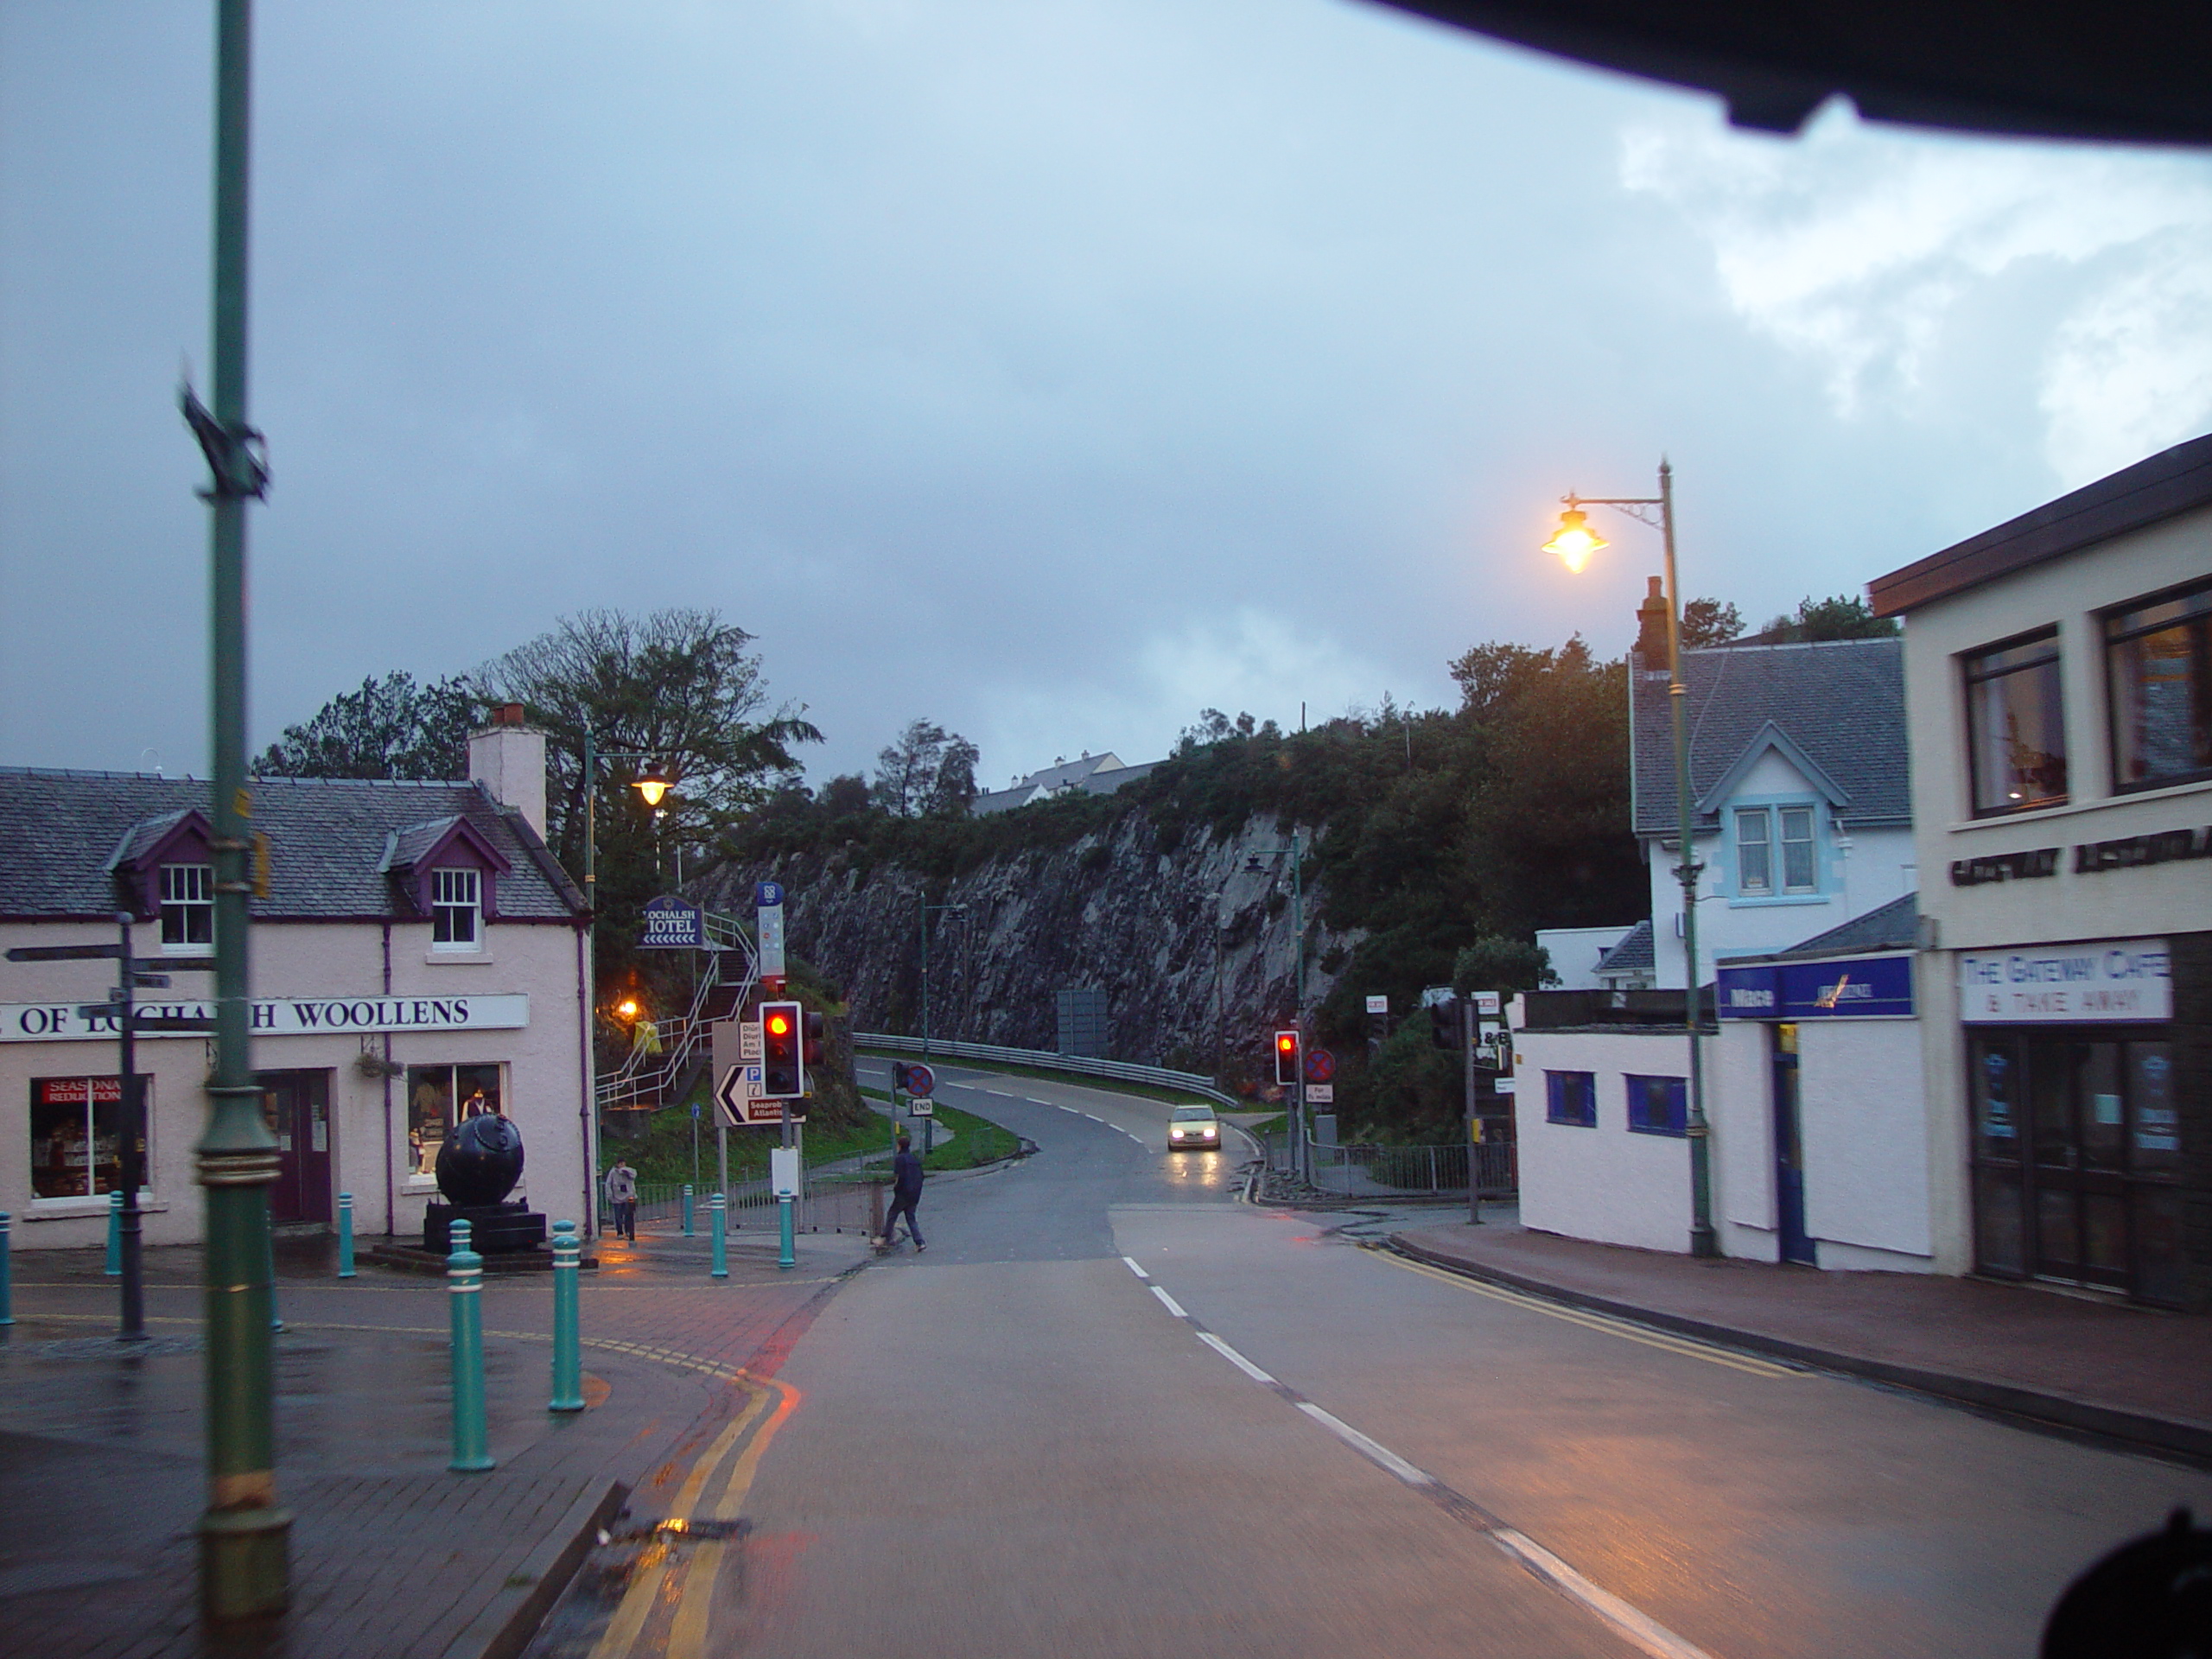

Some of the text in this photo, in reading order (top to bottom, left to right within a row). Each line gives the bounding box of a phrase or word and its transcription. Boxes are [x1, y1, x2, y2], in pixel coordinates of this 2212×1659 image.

[642, 911, 696, 920] OCHALSH
[20, 1007, 68, 1034] OF
[292, 1000, 469, 1028] WOOLLENS
[751, 1101, 782, 1109] Seaprob
[915, 1103, 931, 1111] END
